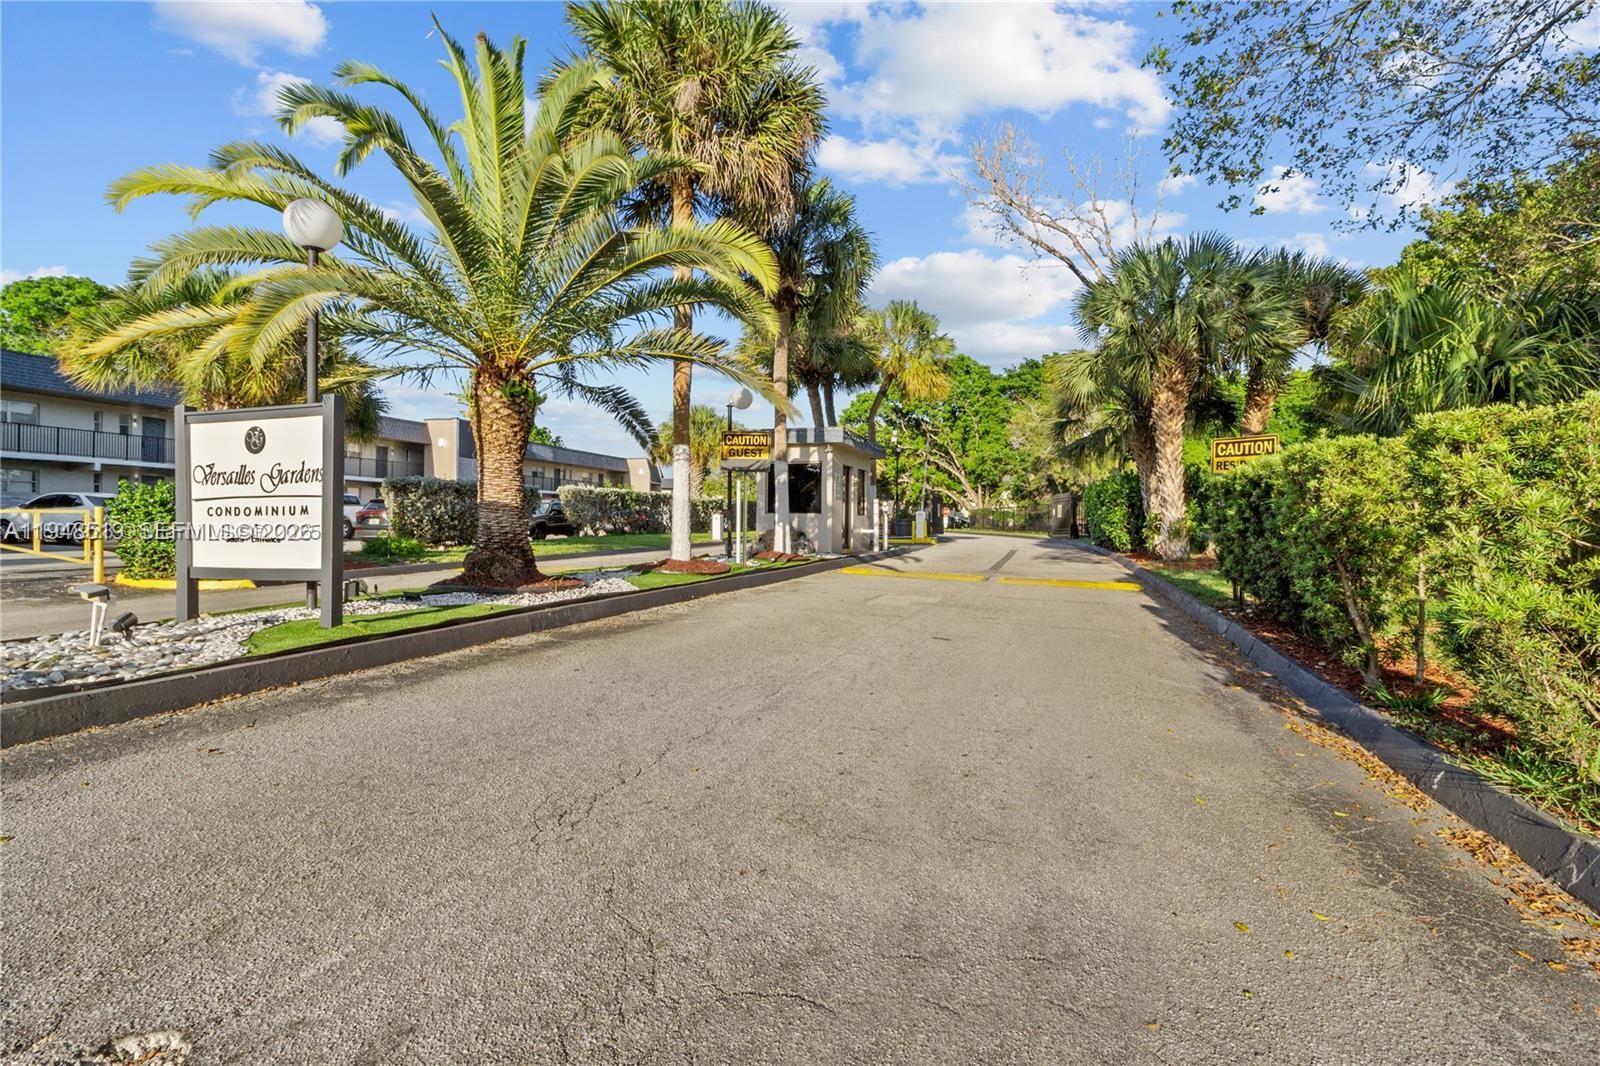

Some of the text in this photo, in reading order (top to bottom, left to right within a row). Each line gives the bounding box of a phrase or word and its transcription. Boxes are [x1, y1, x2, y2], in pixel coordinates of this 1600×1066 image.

[725, 435, 767, 446] CAUTION
[728, 448, 763, 458] GUEST
[1217, 440, 1273, 456] CAUTION
[192, 460, 323, 493] Versailles Gardens
[207, 504, 309, 517] CONDOMINIUM
